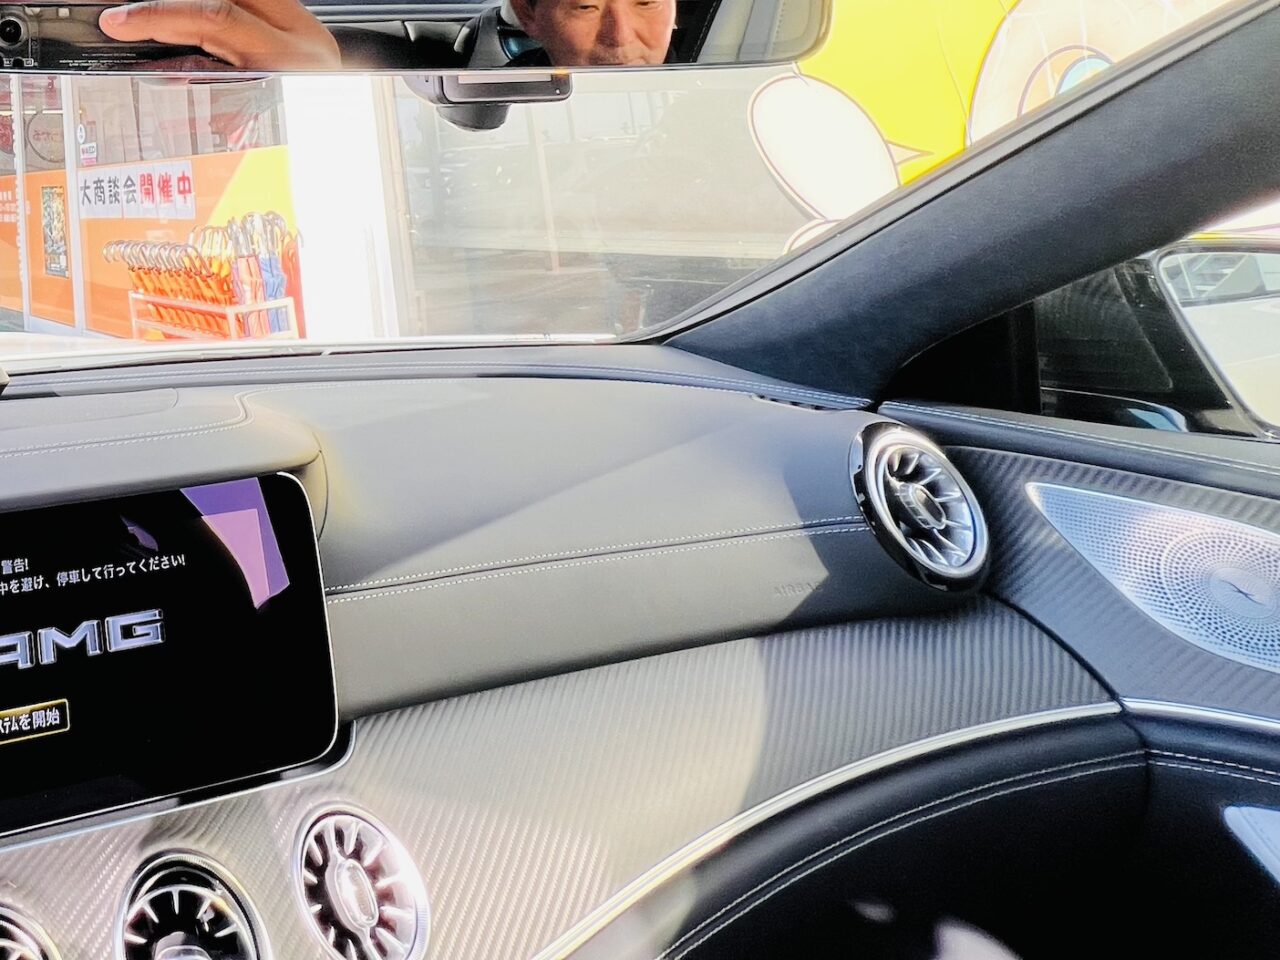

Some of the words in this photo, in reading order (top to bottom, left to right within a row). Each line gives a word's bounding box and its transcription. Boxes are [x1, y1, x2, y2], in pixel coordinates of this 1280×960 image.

[79, 169, 193, 207] 大商談会開催中
